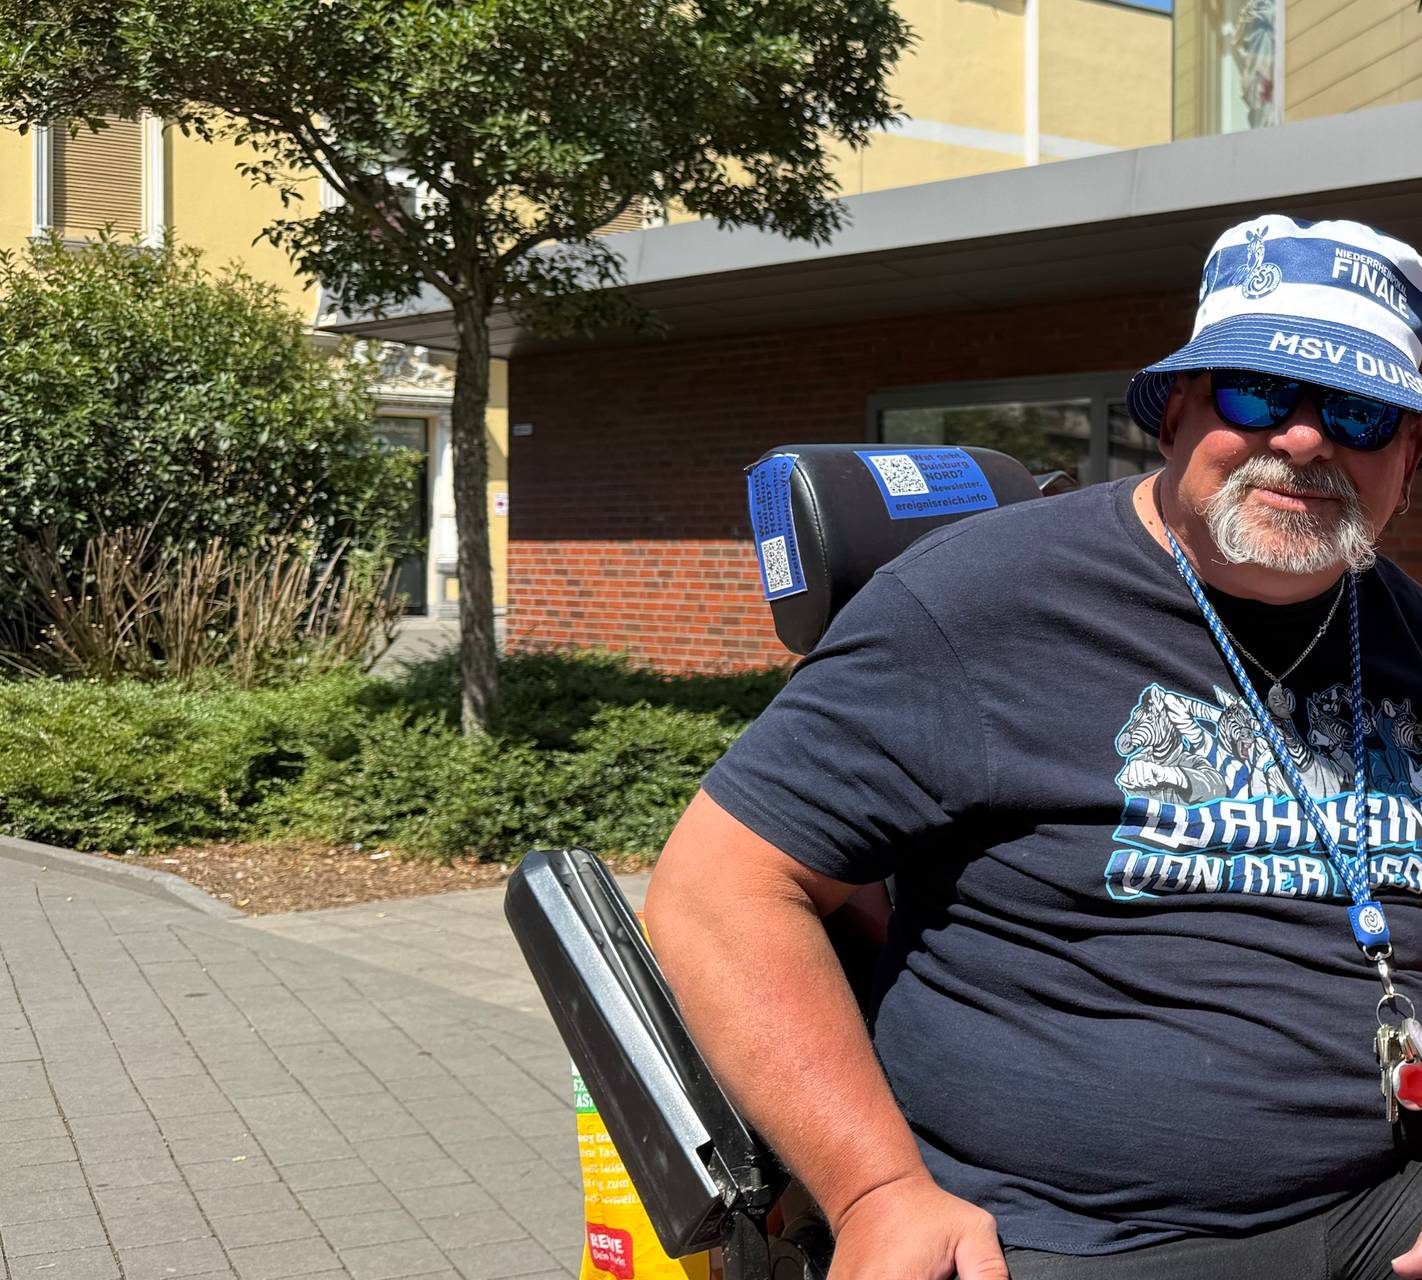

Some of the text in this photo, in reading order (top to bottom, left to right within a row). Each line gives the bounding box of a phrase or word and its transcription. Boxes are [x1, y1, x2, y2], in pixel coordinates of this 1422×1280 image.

[1331, 256, 1410, 320] FINALE
[1268, 331, 1347, 364] MSV
[919, 460, 970, 473] Duisburg
[924, 470, 964, 482] NORD?
[895, 493, 989, 512] ereignisreich.info
[1118, 850, 1222, 895] VON
[1240, 855, 1326, 899] DER
[589, 1232, 624, 1255] REWE
